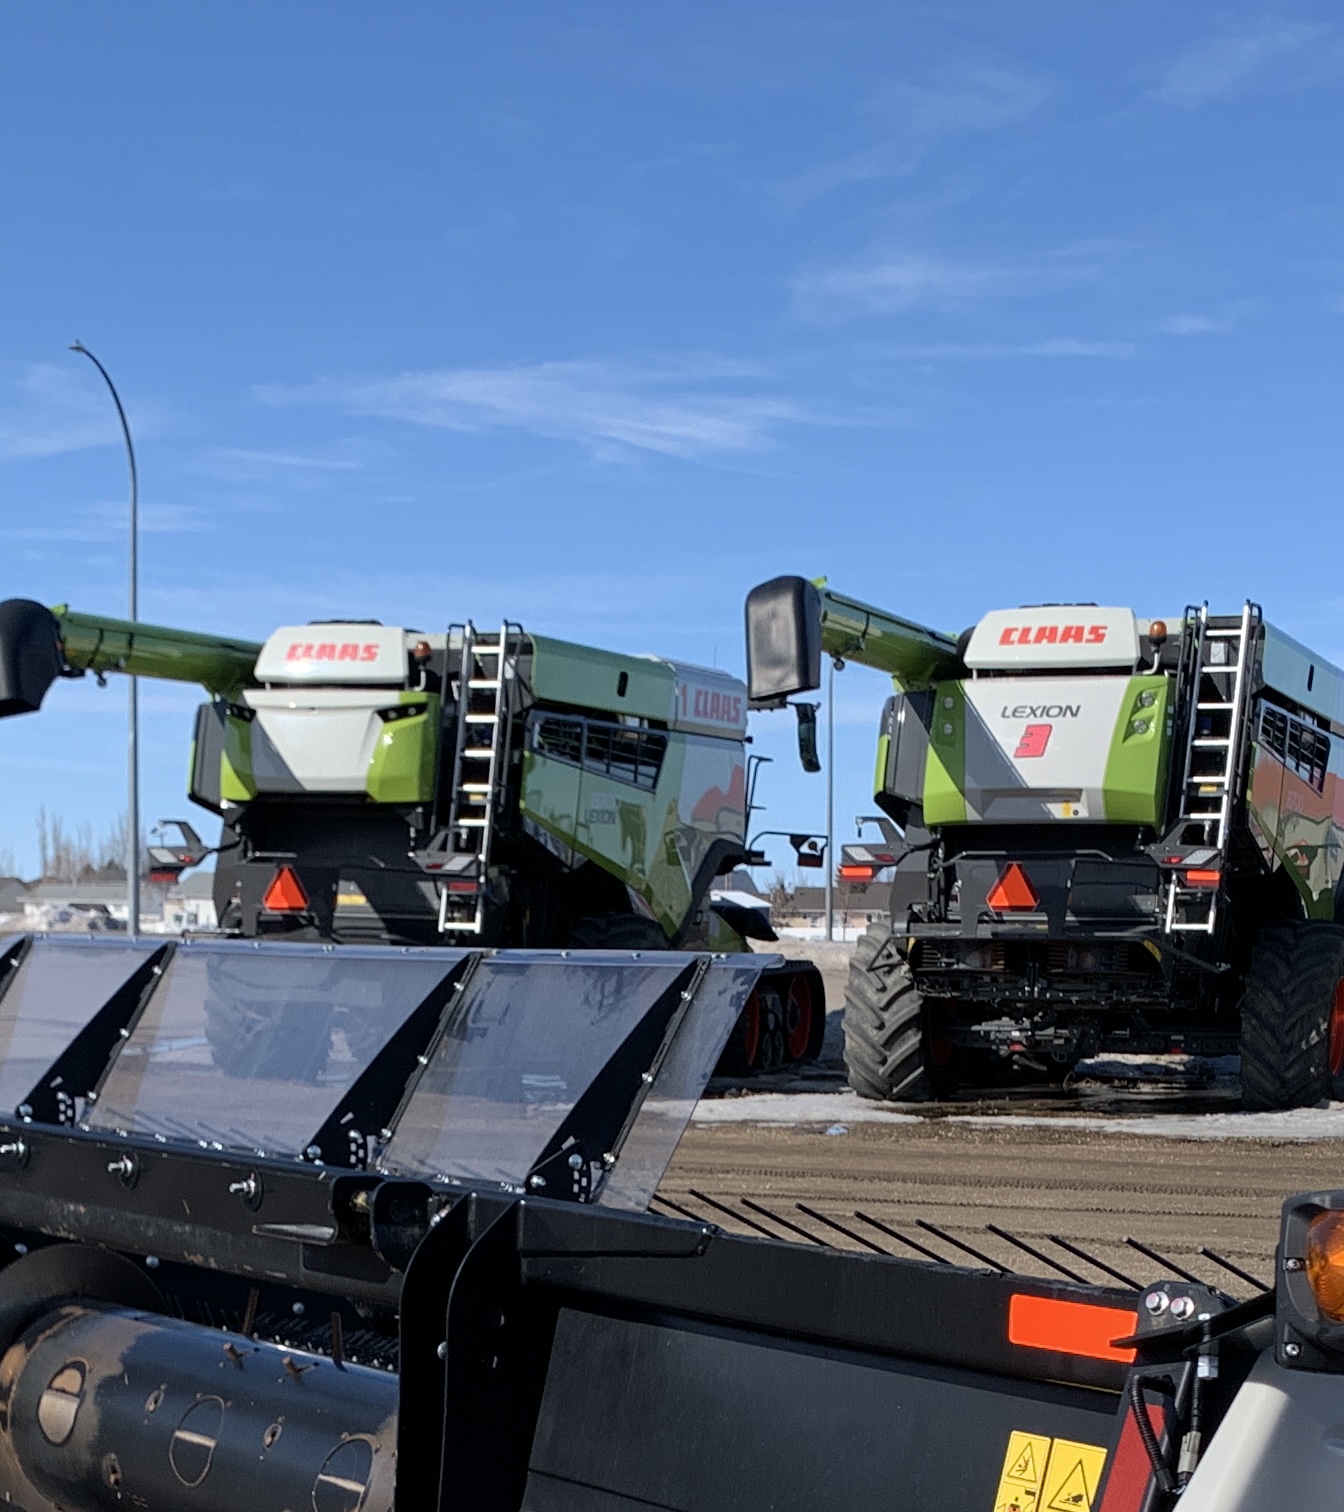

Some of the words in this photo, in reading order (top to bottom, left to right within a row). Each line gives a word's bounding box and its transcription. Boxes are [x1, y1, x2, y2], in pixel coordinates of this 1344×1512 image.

[998, 625, 1108, 646] CLAAS
[285, 643, 380, 662] CLAAS
[694, 688, 742, 724] CLAAS
[1001, 704, 1081, 719] LEXION
[1013, 723, 1053, 759] 3
